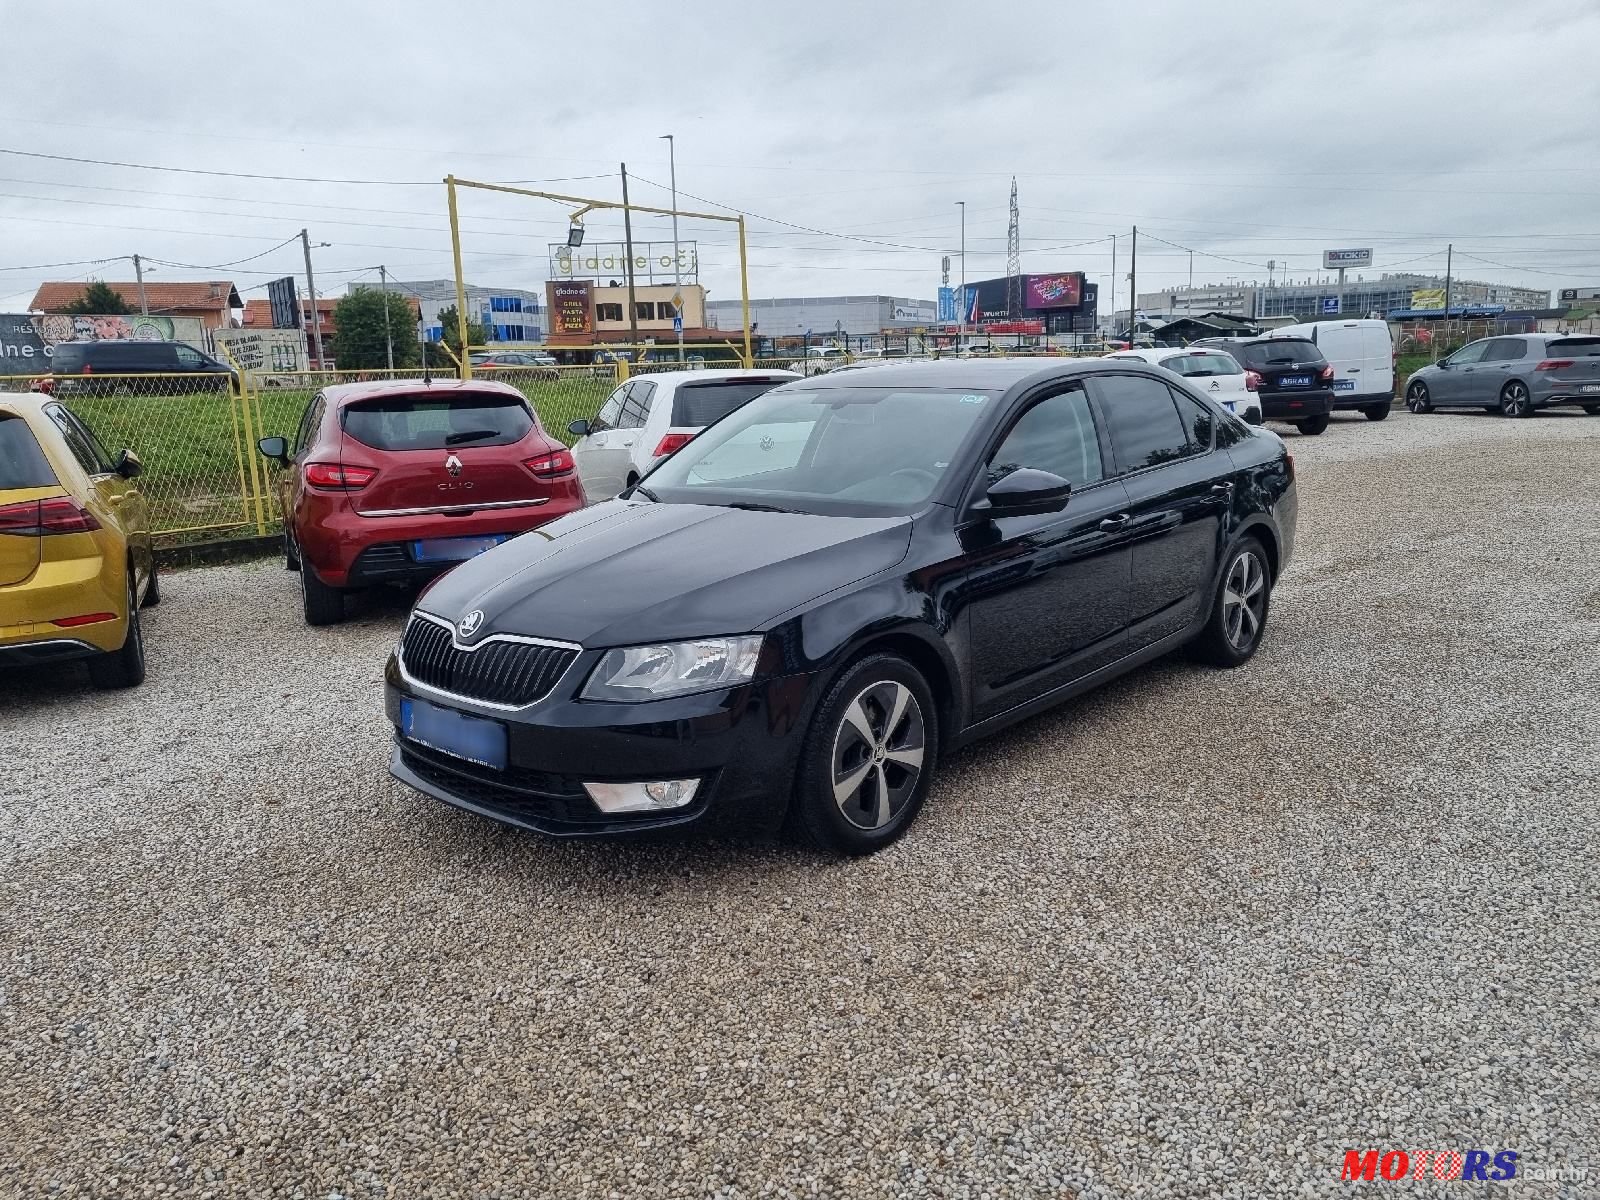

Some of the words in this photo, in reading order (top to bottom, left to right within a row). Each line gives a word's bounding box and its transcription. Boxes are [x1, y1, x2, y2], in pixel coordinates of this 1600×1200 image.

[1282, 377, 1309, 385] AGRAM
[1333, 383, 1353, 391] GRAM
[438, 482, 474, 490] CLIO
